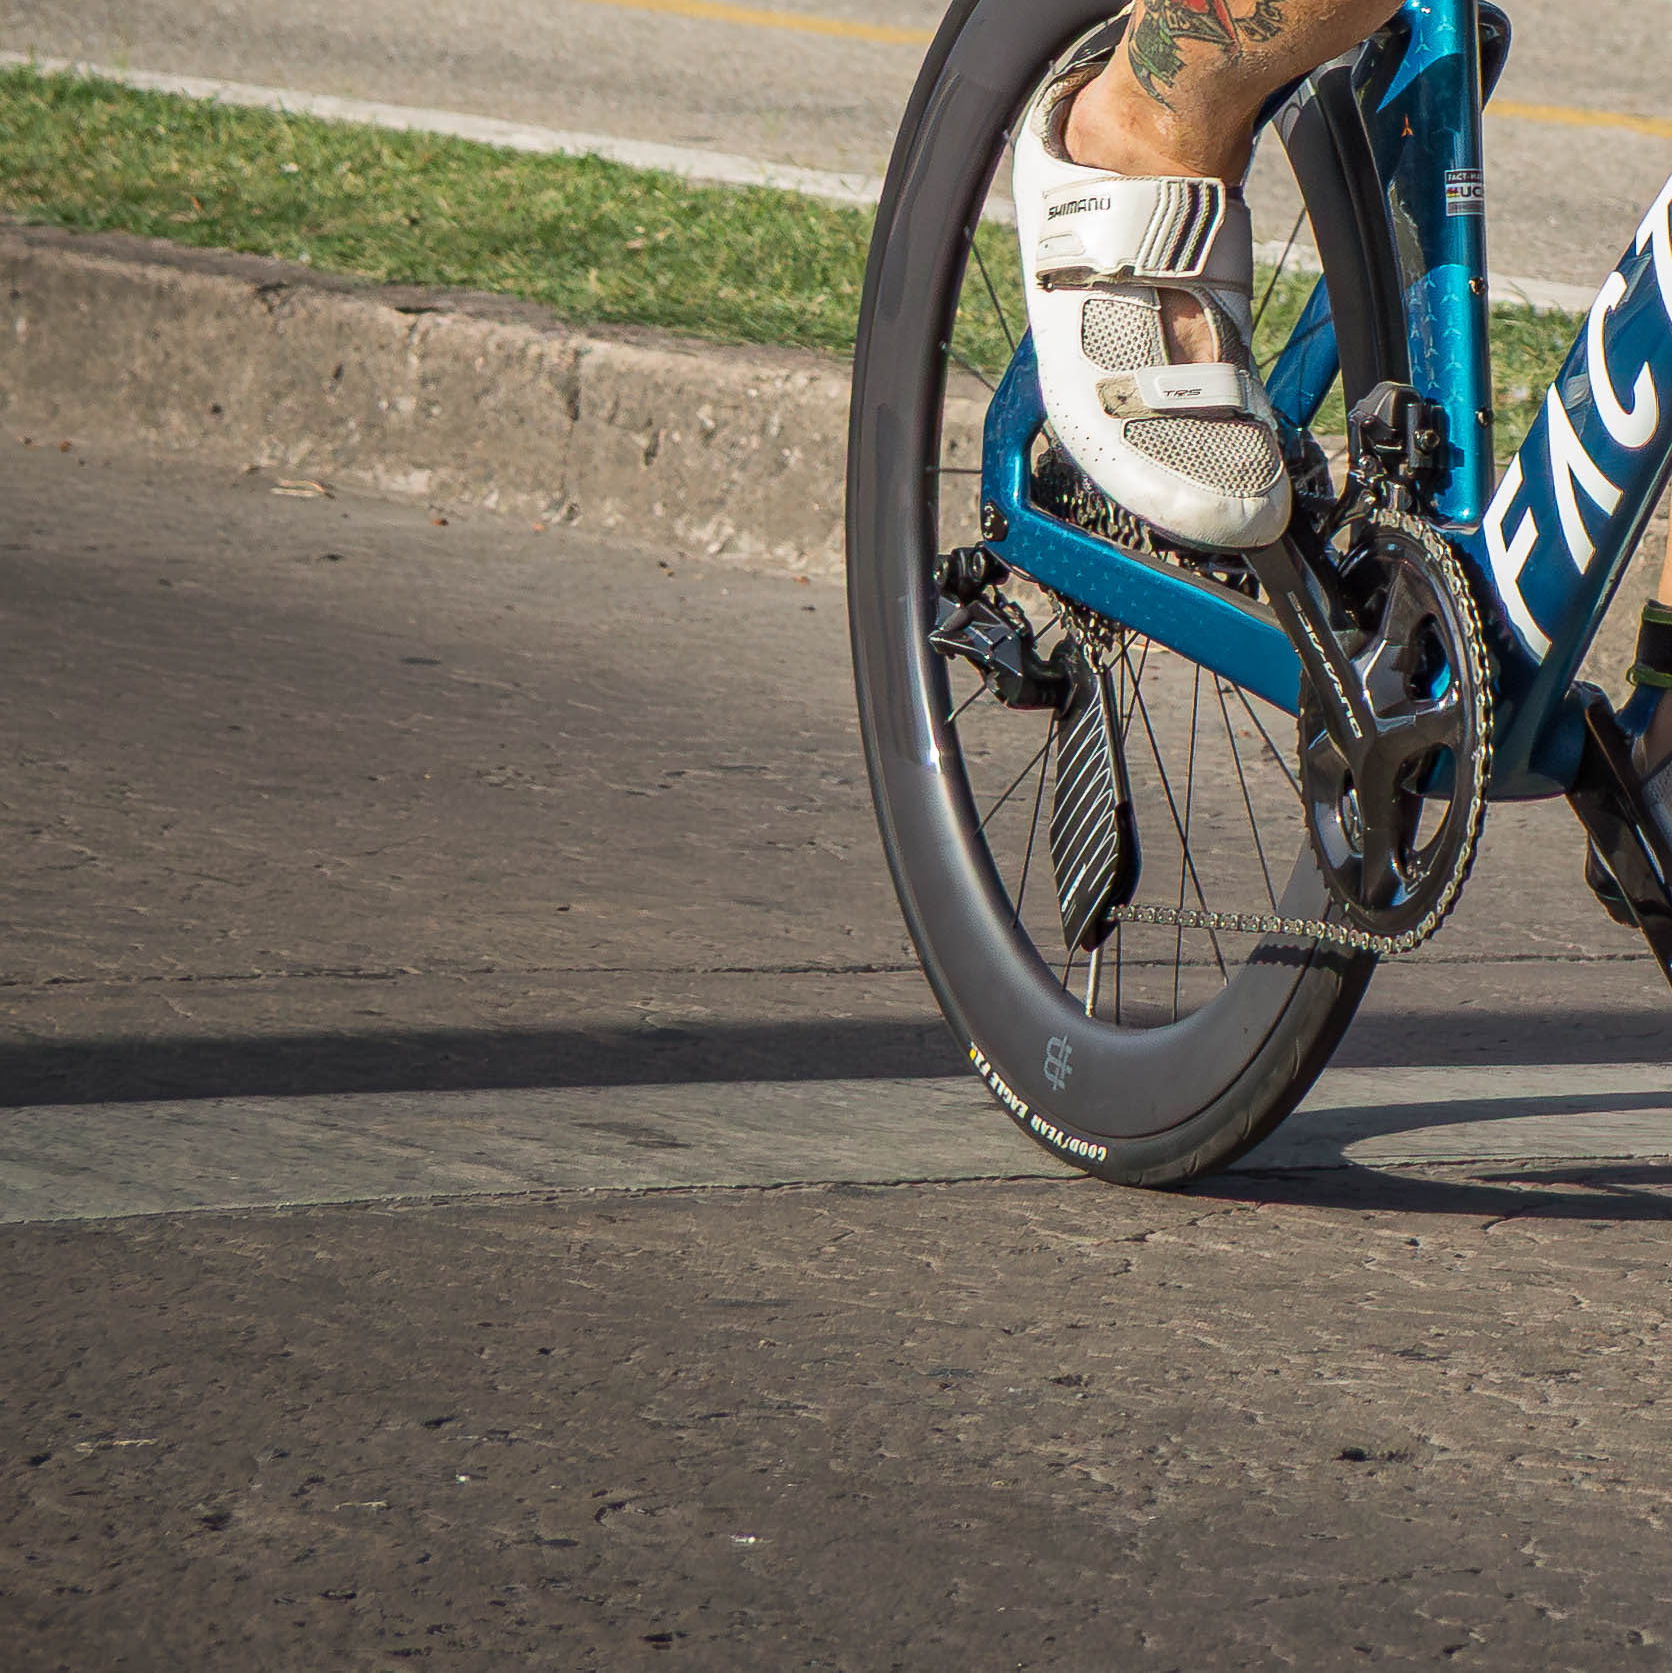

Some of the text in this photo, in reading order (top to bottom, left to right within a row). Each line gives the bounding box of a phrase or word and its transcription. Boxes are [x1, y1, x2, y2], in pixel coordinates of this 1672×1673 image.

[1048, 197, 1111, 221] SHIMANO
[988, 1071, 1029, 1119] EAGLE
[1030, 1114, 1107, 1162] GOODYEAR
